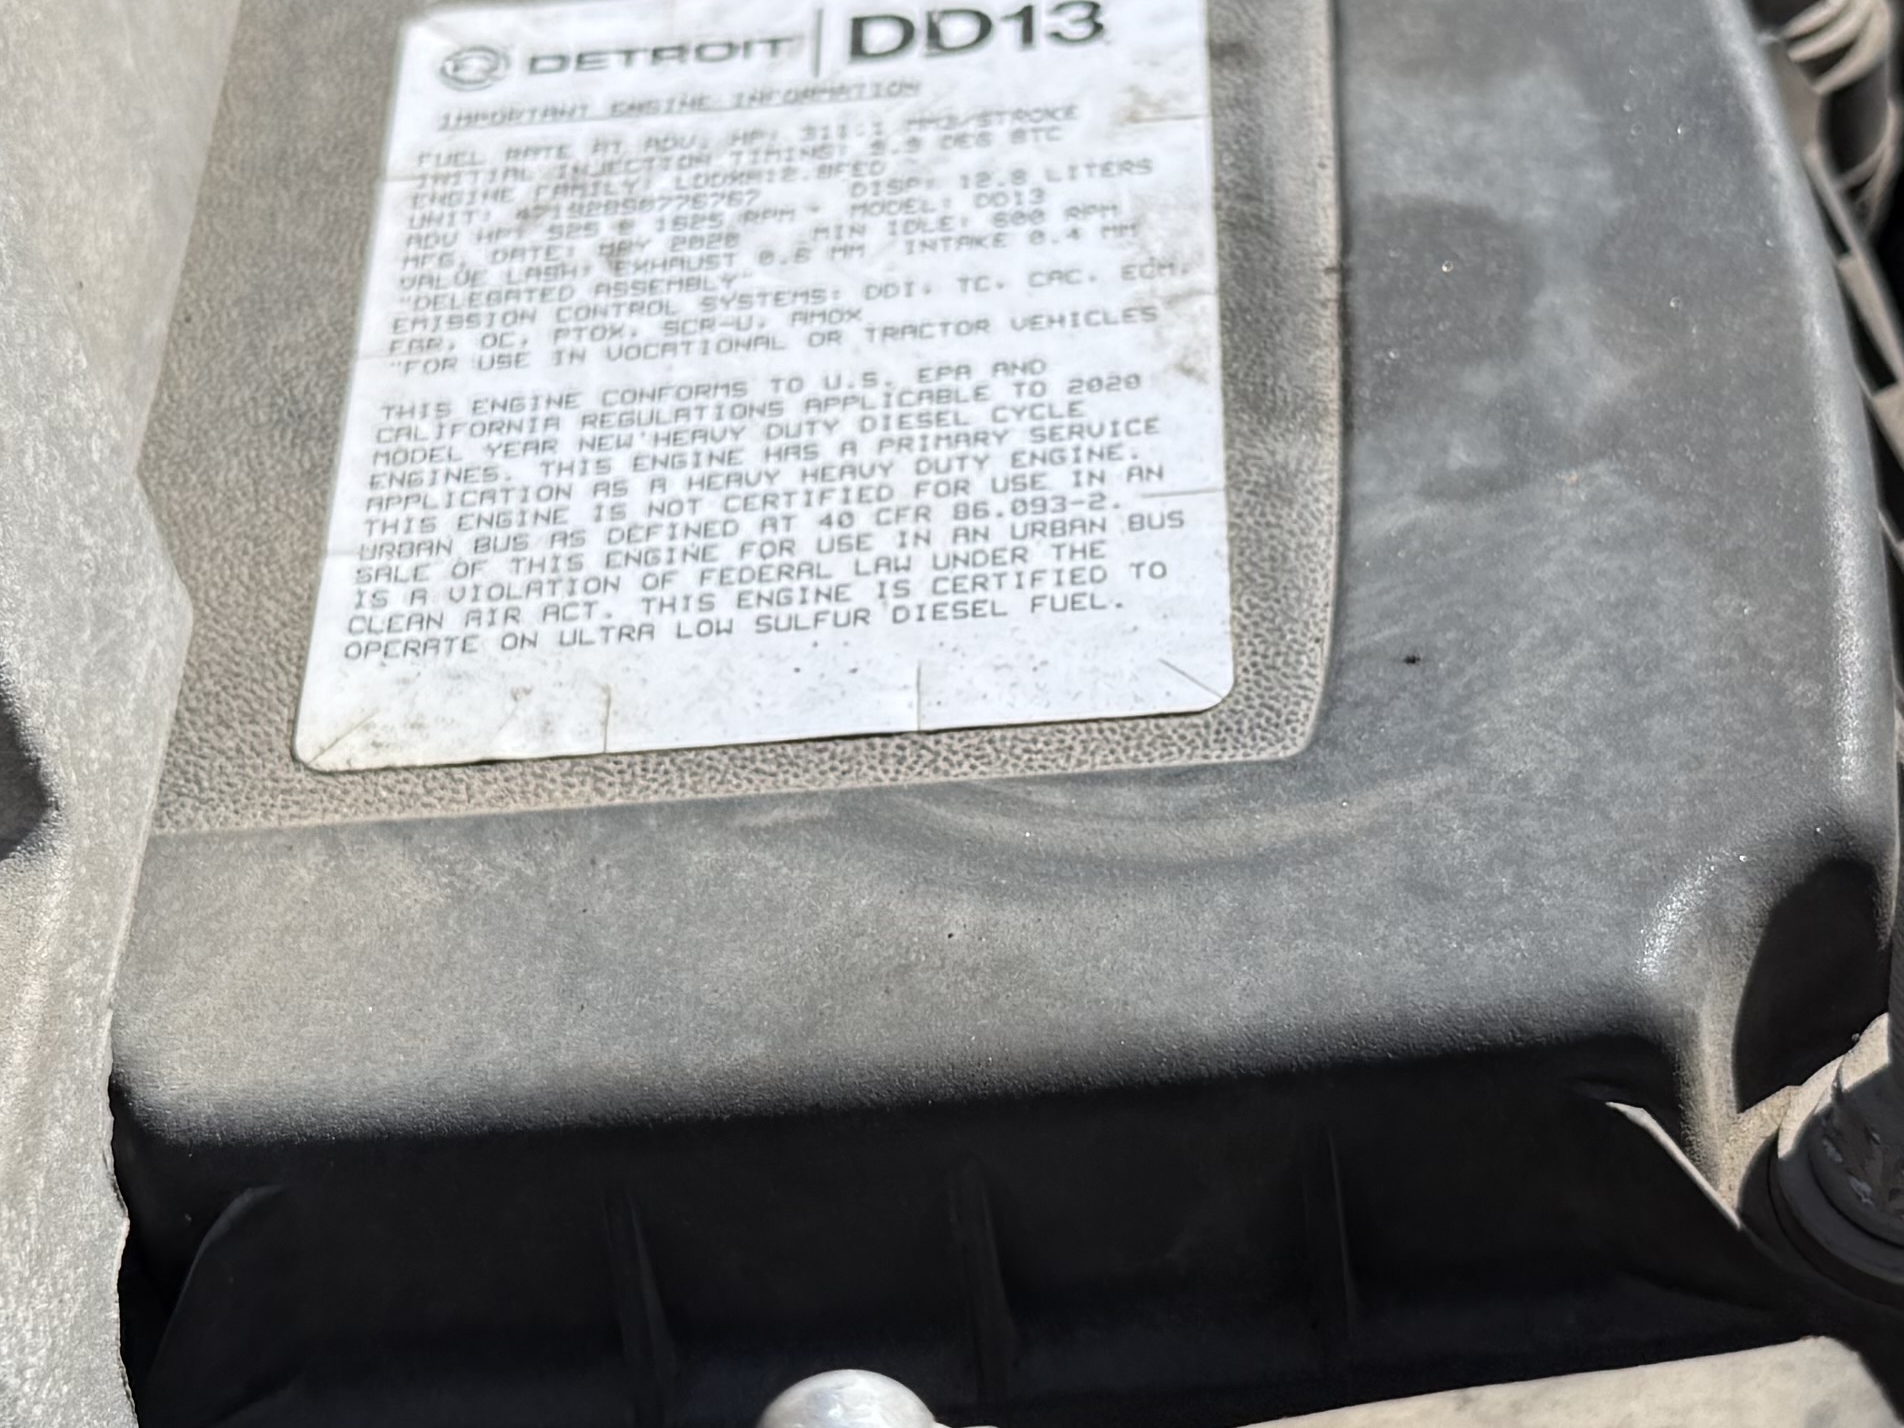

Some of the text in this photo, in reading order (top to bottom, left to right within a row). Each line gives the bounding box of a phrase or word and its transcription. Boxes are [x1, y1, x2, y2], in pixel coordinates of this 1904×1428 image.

[526, 32, 799, 79] DETROIT
[438, 76, 923, 131] IMPORTANT ENGINE INFORMATION
[409, 165, 534, 191] INITIAL
[556, 151, 712, 180] INJECTION
[939, 129, 991, 150] DEG
[1009, 124, 1061, 145] BTC
[415, 149, 485, 171] FUEL
[503, 143, 569, 164] RATE
[590, 138, 623, 157] AT
[728, 126, 777, 147] HP:
[408, 186, 513, 211] ENGINE
[848, 186, 1046, 218] MODEL: DD13
[849, 157, 1153, 197] DISP: 12.8 LITERS
[403, 231, 459, 252] ADV
[473, 226, 525, 247] HP:
[544, 220, 600, 241] 525
[653, 211, 725, 233] 1625
[738, 205, 796, 227] RPM
[406, 208, 492, 232] UNIT:
[811, 201, 1119, 242] MIN IDLE: 600 RPM
[903, 219, 1142, 255] INTAKE 0.4 MM
[396, 270, 488, 294] VALVE
[503, 261, 592, 286] LASH:
[609, 250, 736, 277] EXHAUST
[828, 240, 866, 261] MM
[488, 243, 575, 267] DATE:
[596, 237, 652, 258] MAY
[668, 230, 740, 253] 2020
[389, 308, 538, 337] EMISSION
[553, 297, 679, 324] CONTROL
[698, 285, 841, 313] SYSTEMS:
[475, 351, 531, 373] USE
[551, 347, 587, 367] IN
[603, 331, 788, 363] VOCATIONAL
[805, 327, 843, 348] OR
[862, 316, 991, 344] TRACTOR
[1009, 303, 1158, 332] VEHICLES
[789, 304, 863, 328] AMOX
[372, 371, 1142, 447] CALIFORNIA REGULATIONS APPLICABLE TO 2020
[377, 355, 1048, 424] THIS ENGINE CONFORMS TO U.S. EPA AND
[366, 415, 1160, 493] ENGINES. THIS ENGINE HAS A PRIMARY SERVICE
[369, 398, 1085, 470] MODEL YEAR NEW HEAVY DUTY DIESEL CYCLE
[360, 461, 1165, 540] THIS ENGINE IS NOT CERTIFIED FOR USE IN AN
[362, 440, 1139, 517] APPLICATION AS A HEAVY HEAVY DUTY ENGINE.
[352, 508, 1186, 589] SALE OF THIS ENGINE FOR USE IN AN URBAN BUS
[353, 489, 1121, 565] URBAN BUS AS DEFINED AT 40 CFR 86.093-2.
[344, 558, 1168, 639] CLEAN AIR ACT. THIS ENGINE IS CERTIFIED TO
[352, 538, 1108, 613] IS A VIOLATION OF FEDERAL LAW UNDER THE
[341, 587, 1124, 664] OPERATE ON ULTRA LOW SULFUR DIESEL FUEL.
